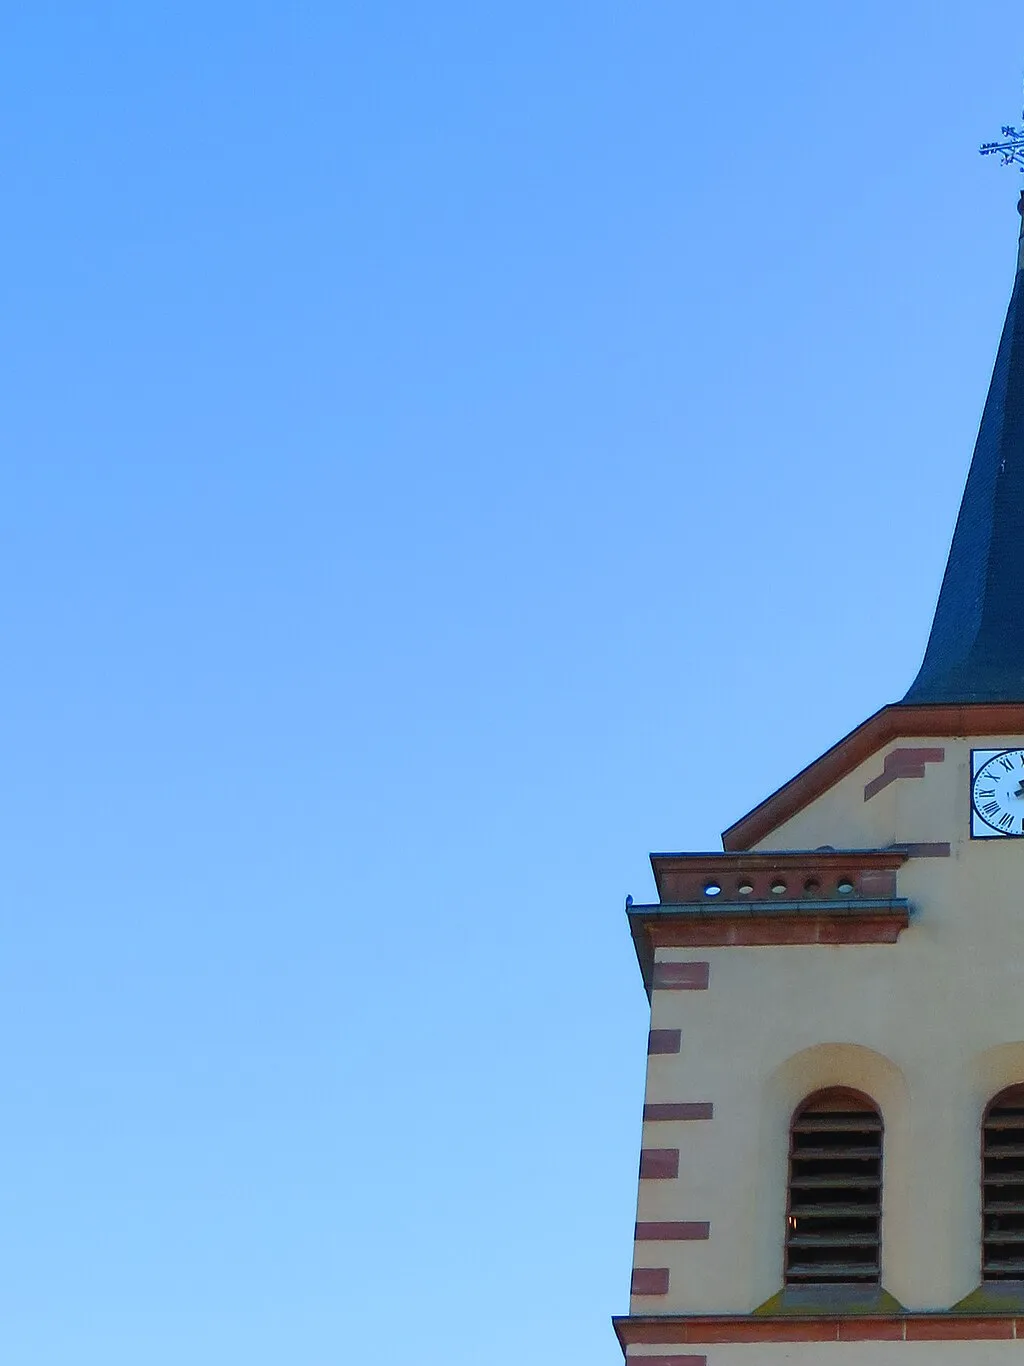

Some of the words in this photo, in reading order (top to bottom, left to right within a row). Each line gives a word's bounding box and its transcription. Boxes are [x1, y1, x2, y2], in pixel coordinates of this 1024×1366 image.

[999, 758, 1015, 773] XI
[983, 770, 1001, 783] X
[979, 789, 996, 798] IX
[982, 800, 1002, 818] VIII
[998, 812, 1015, 829] VII
